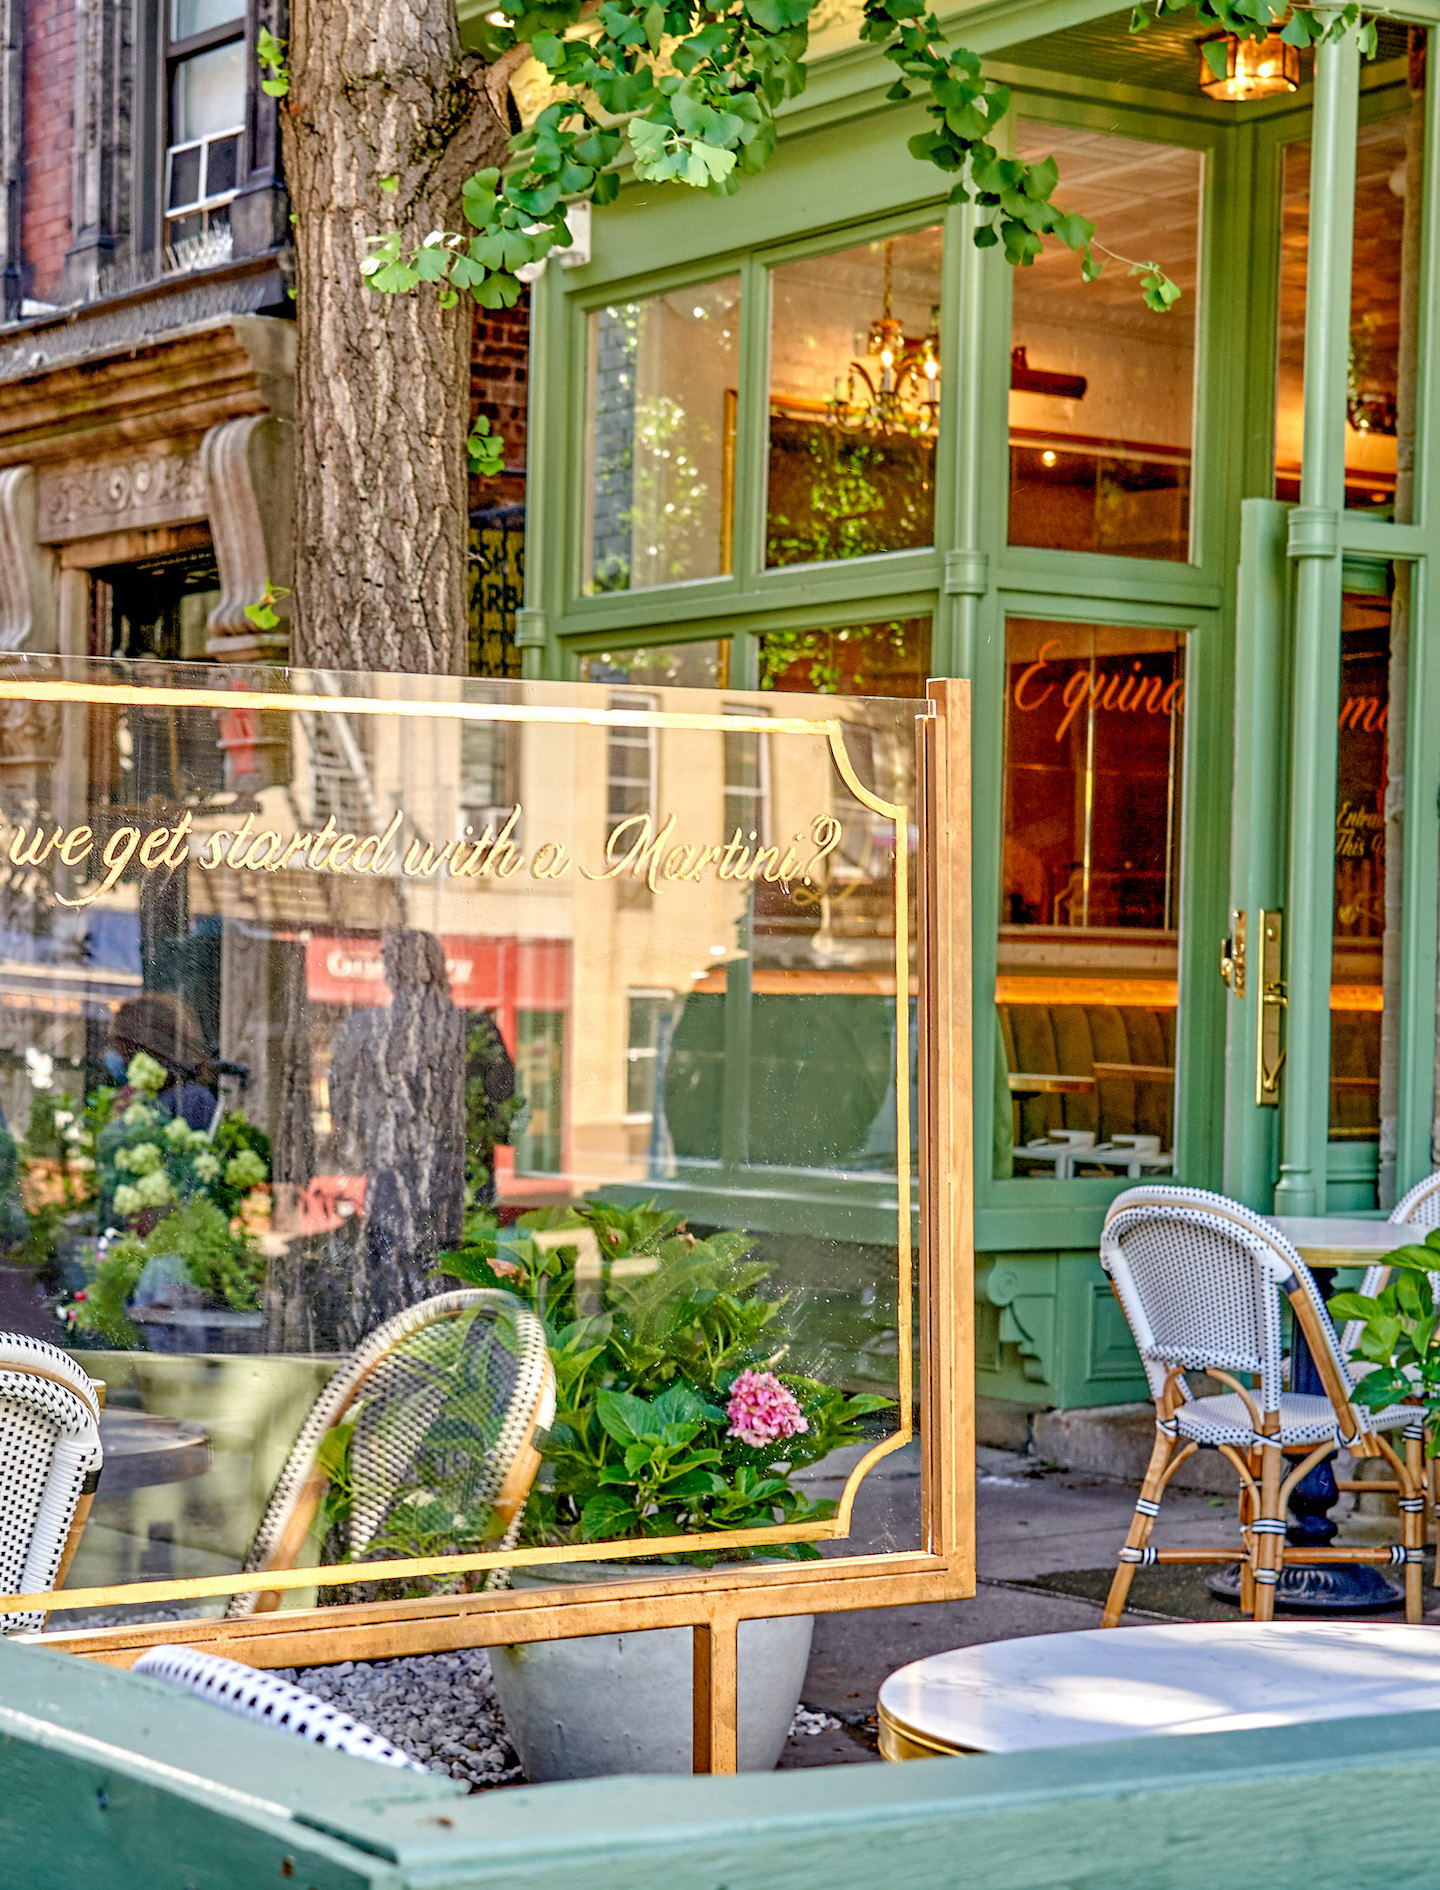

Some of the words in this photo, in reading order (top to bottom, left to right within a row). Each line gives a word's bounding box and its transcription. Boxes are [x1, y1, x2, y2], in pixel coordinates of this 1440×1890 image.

[9, 825, 94, 867] we
[55, 810, 194, 907] get
[198, 809, 403, 874] started
[402, 803, 525, 879] with
[533, 839, 574, 880] a
[579, 813, 843, 895] Martini?
